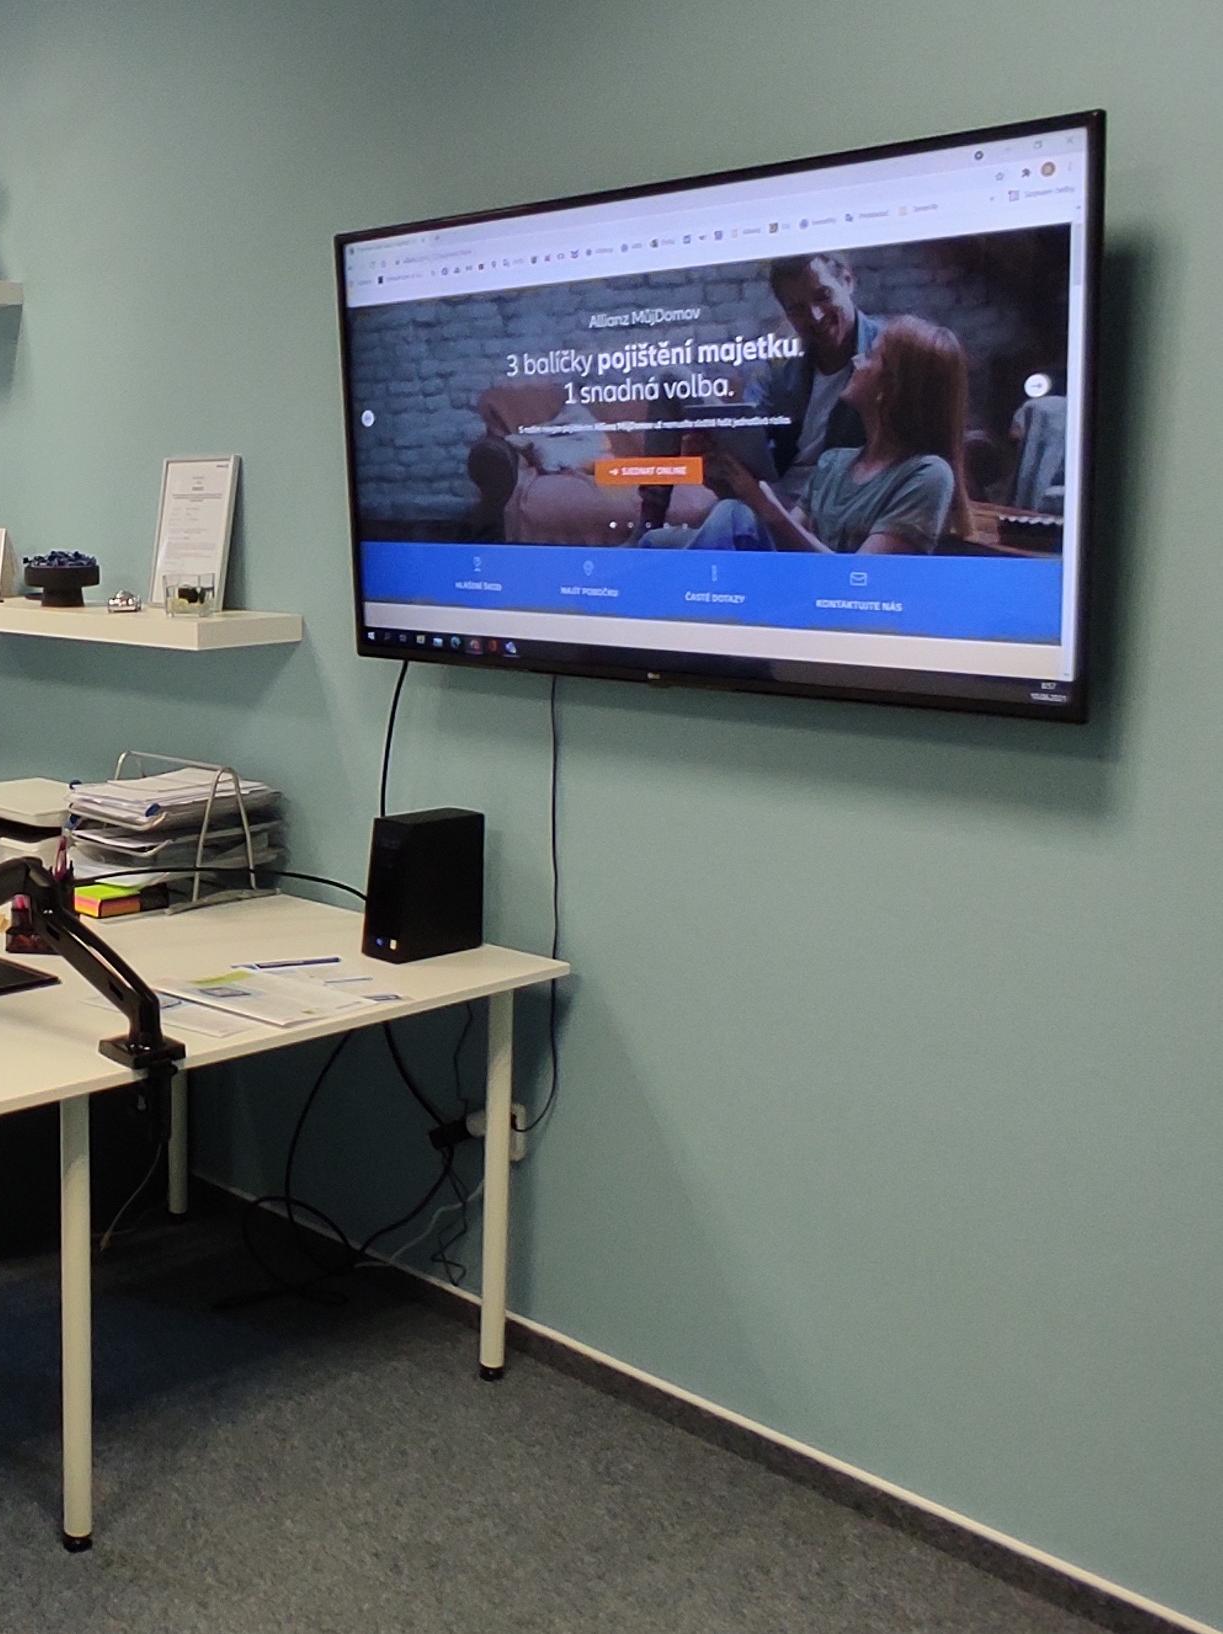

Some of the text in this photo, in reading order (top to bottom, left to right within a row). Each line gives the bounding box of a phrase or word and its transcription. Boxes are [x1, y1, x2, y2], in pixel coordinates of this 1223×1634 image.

[588, 307, 701, 329] Allianz MůjDomov
[506, 332, 805, 377] 3 balíčky pojištění majetku.
[564, 373, 735, 405] 1 snadná volba.
[882, 600, 904, 612] NÁS
